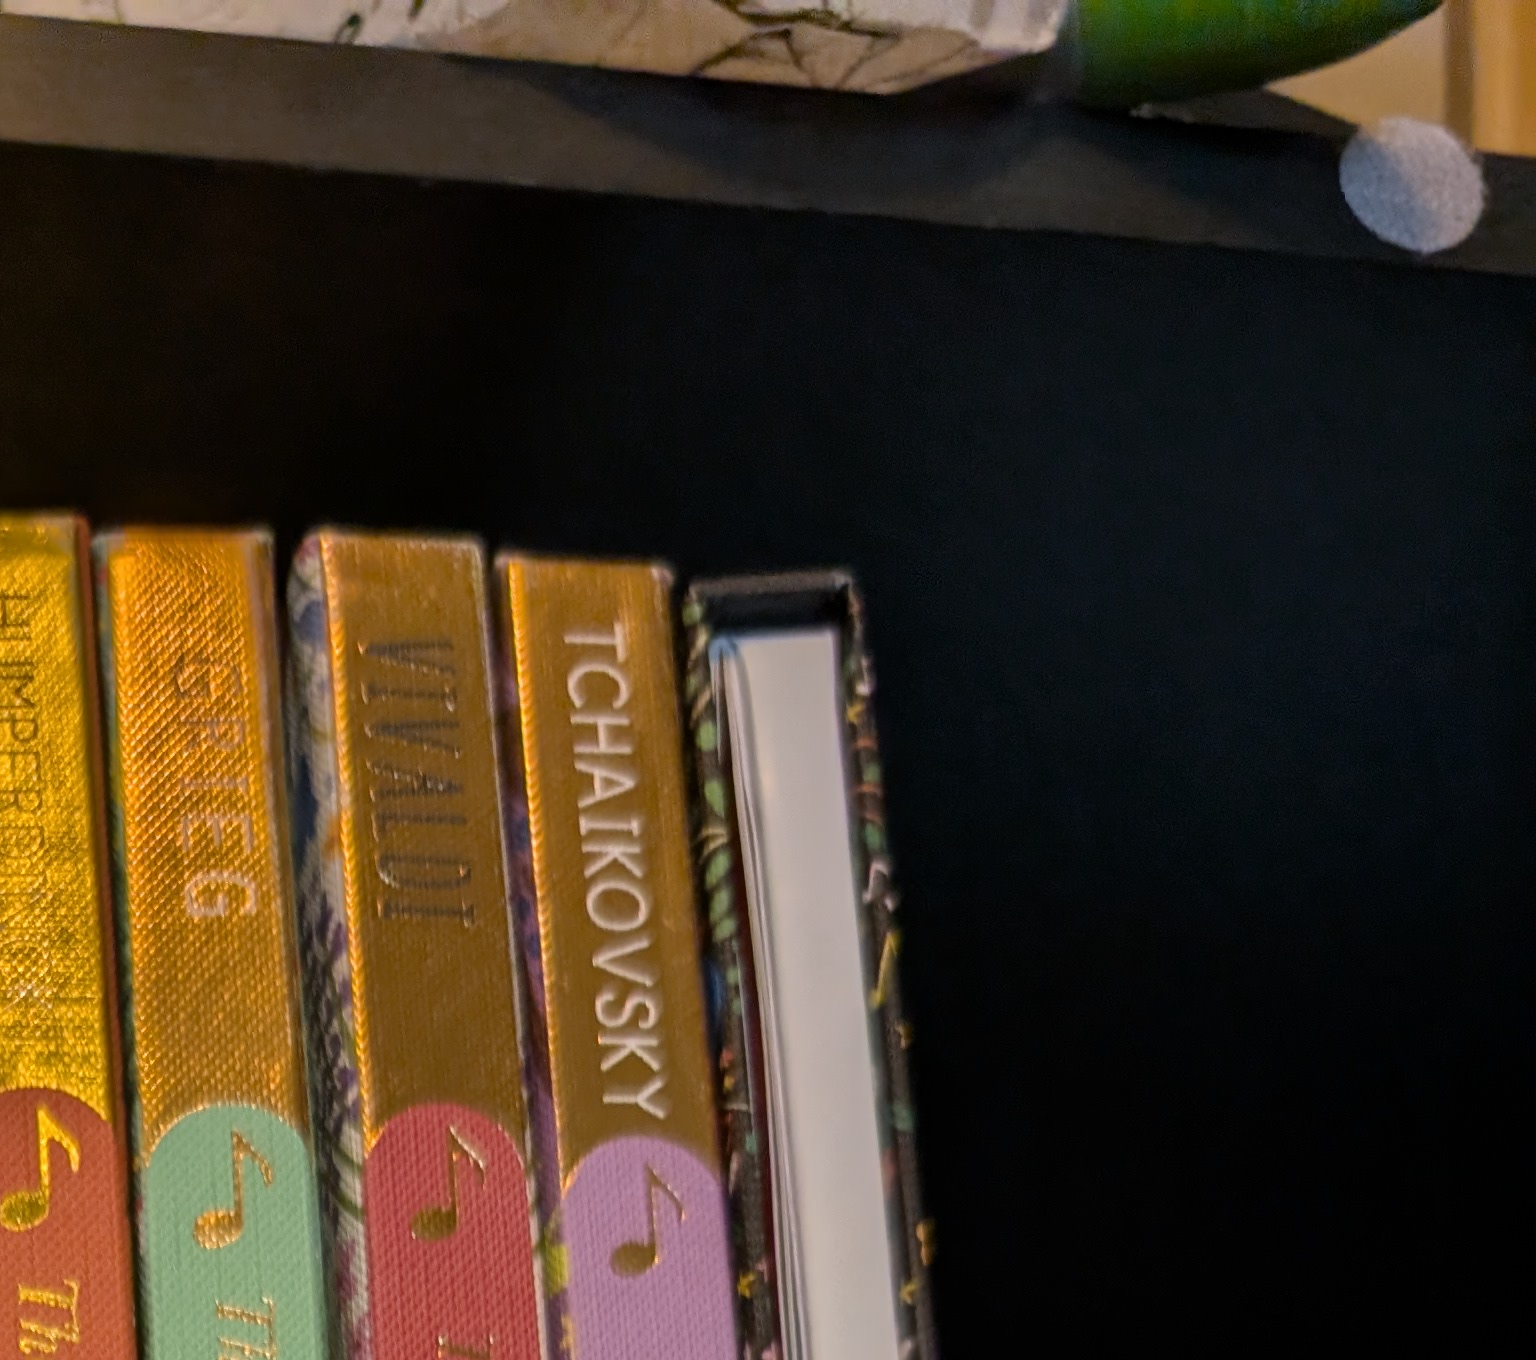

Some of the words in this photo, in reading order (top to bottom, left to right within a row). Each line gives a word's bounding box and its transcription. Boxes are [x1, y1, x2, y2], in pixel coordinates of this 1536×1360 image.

[174, 655, 258, 919] GRIEG
[359, 639, 475, 926] VIVALDI
[565, 621, 670, 1120] TCHAIKOVSKY
